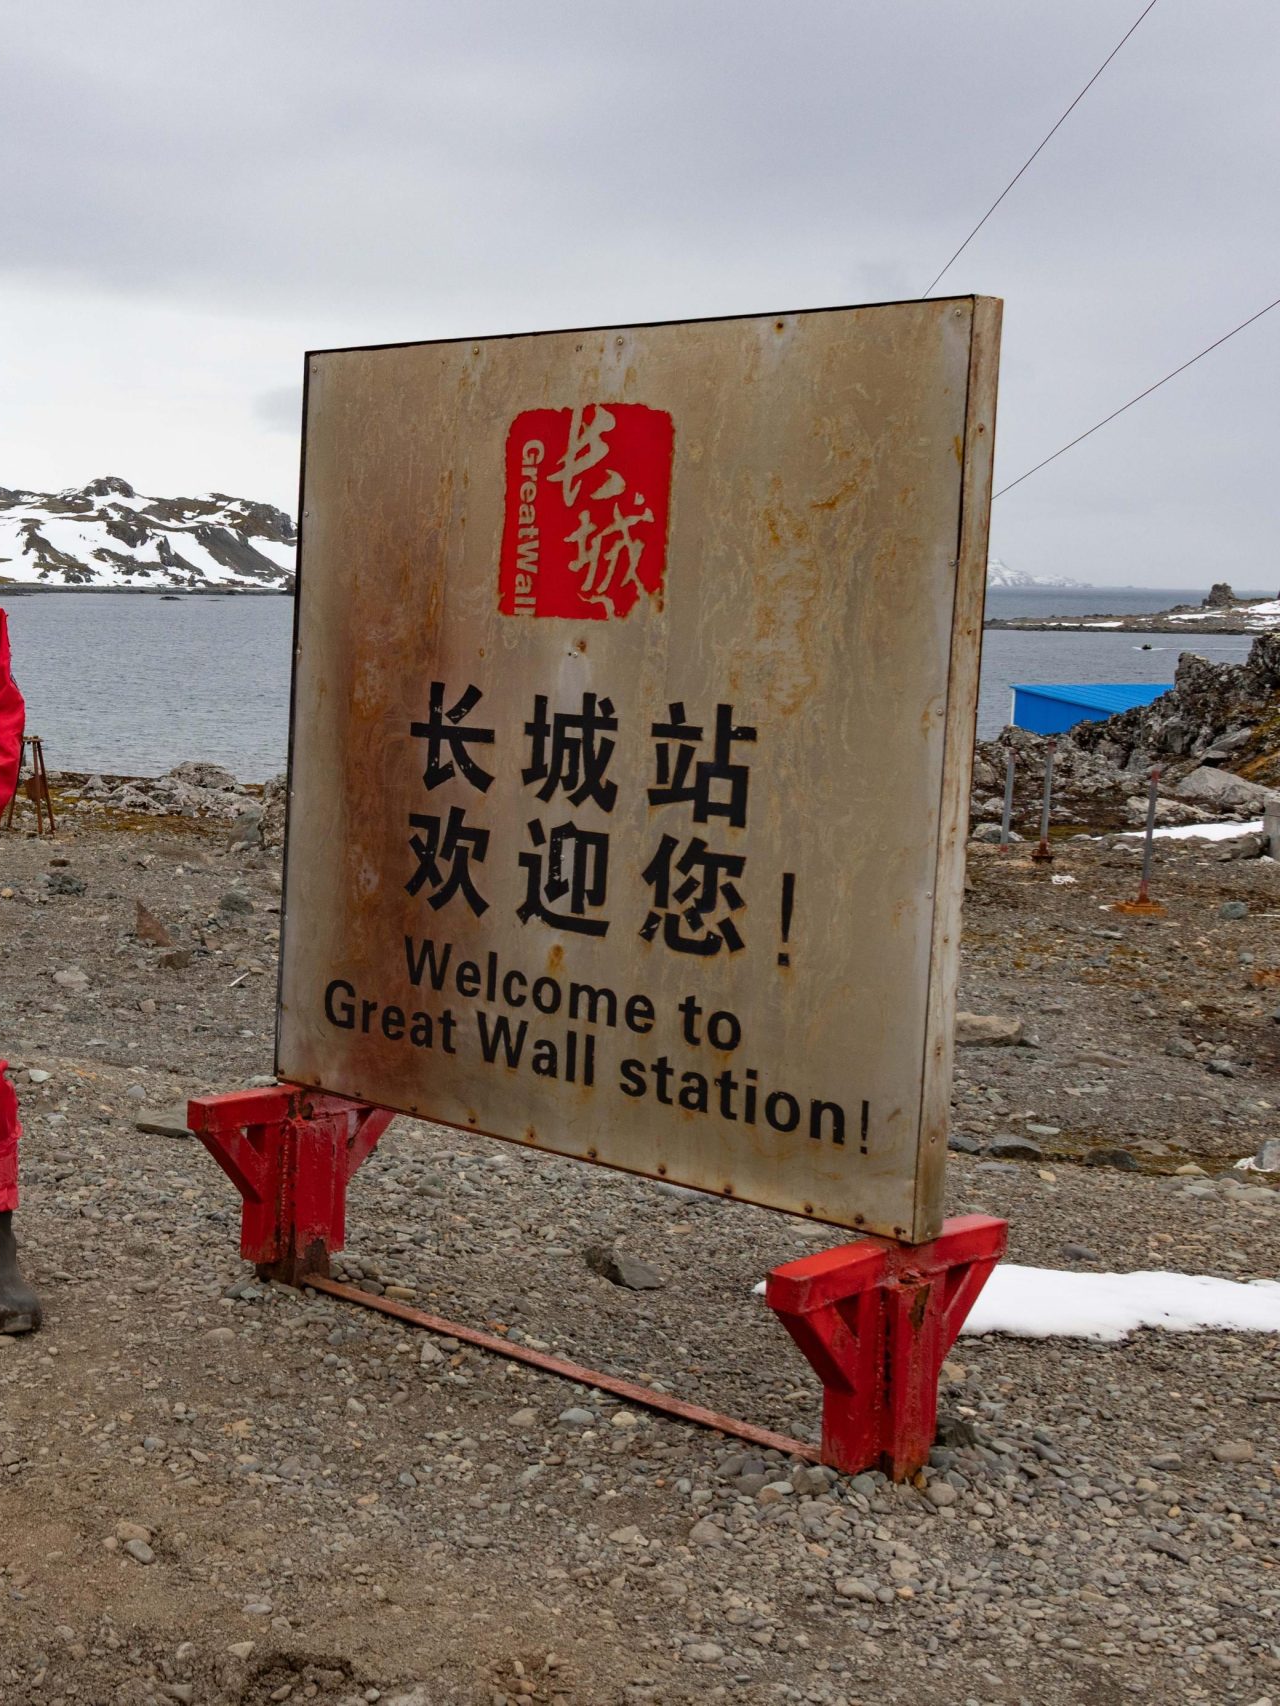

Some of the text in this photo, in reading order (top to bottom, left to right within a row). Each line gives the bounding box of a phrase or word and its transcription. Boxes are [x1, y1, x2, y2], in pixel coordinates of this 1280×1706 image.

[410, 681, 757, 828] 长城站
[404, 935, 742, 1051] Welcome to
[324, 979, 870, 1155] Great Wall station!
